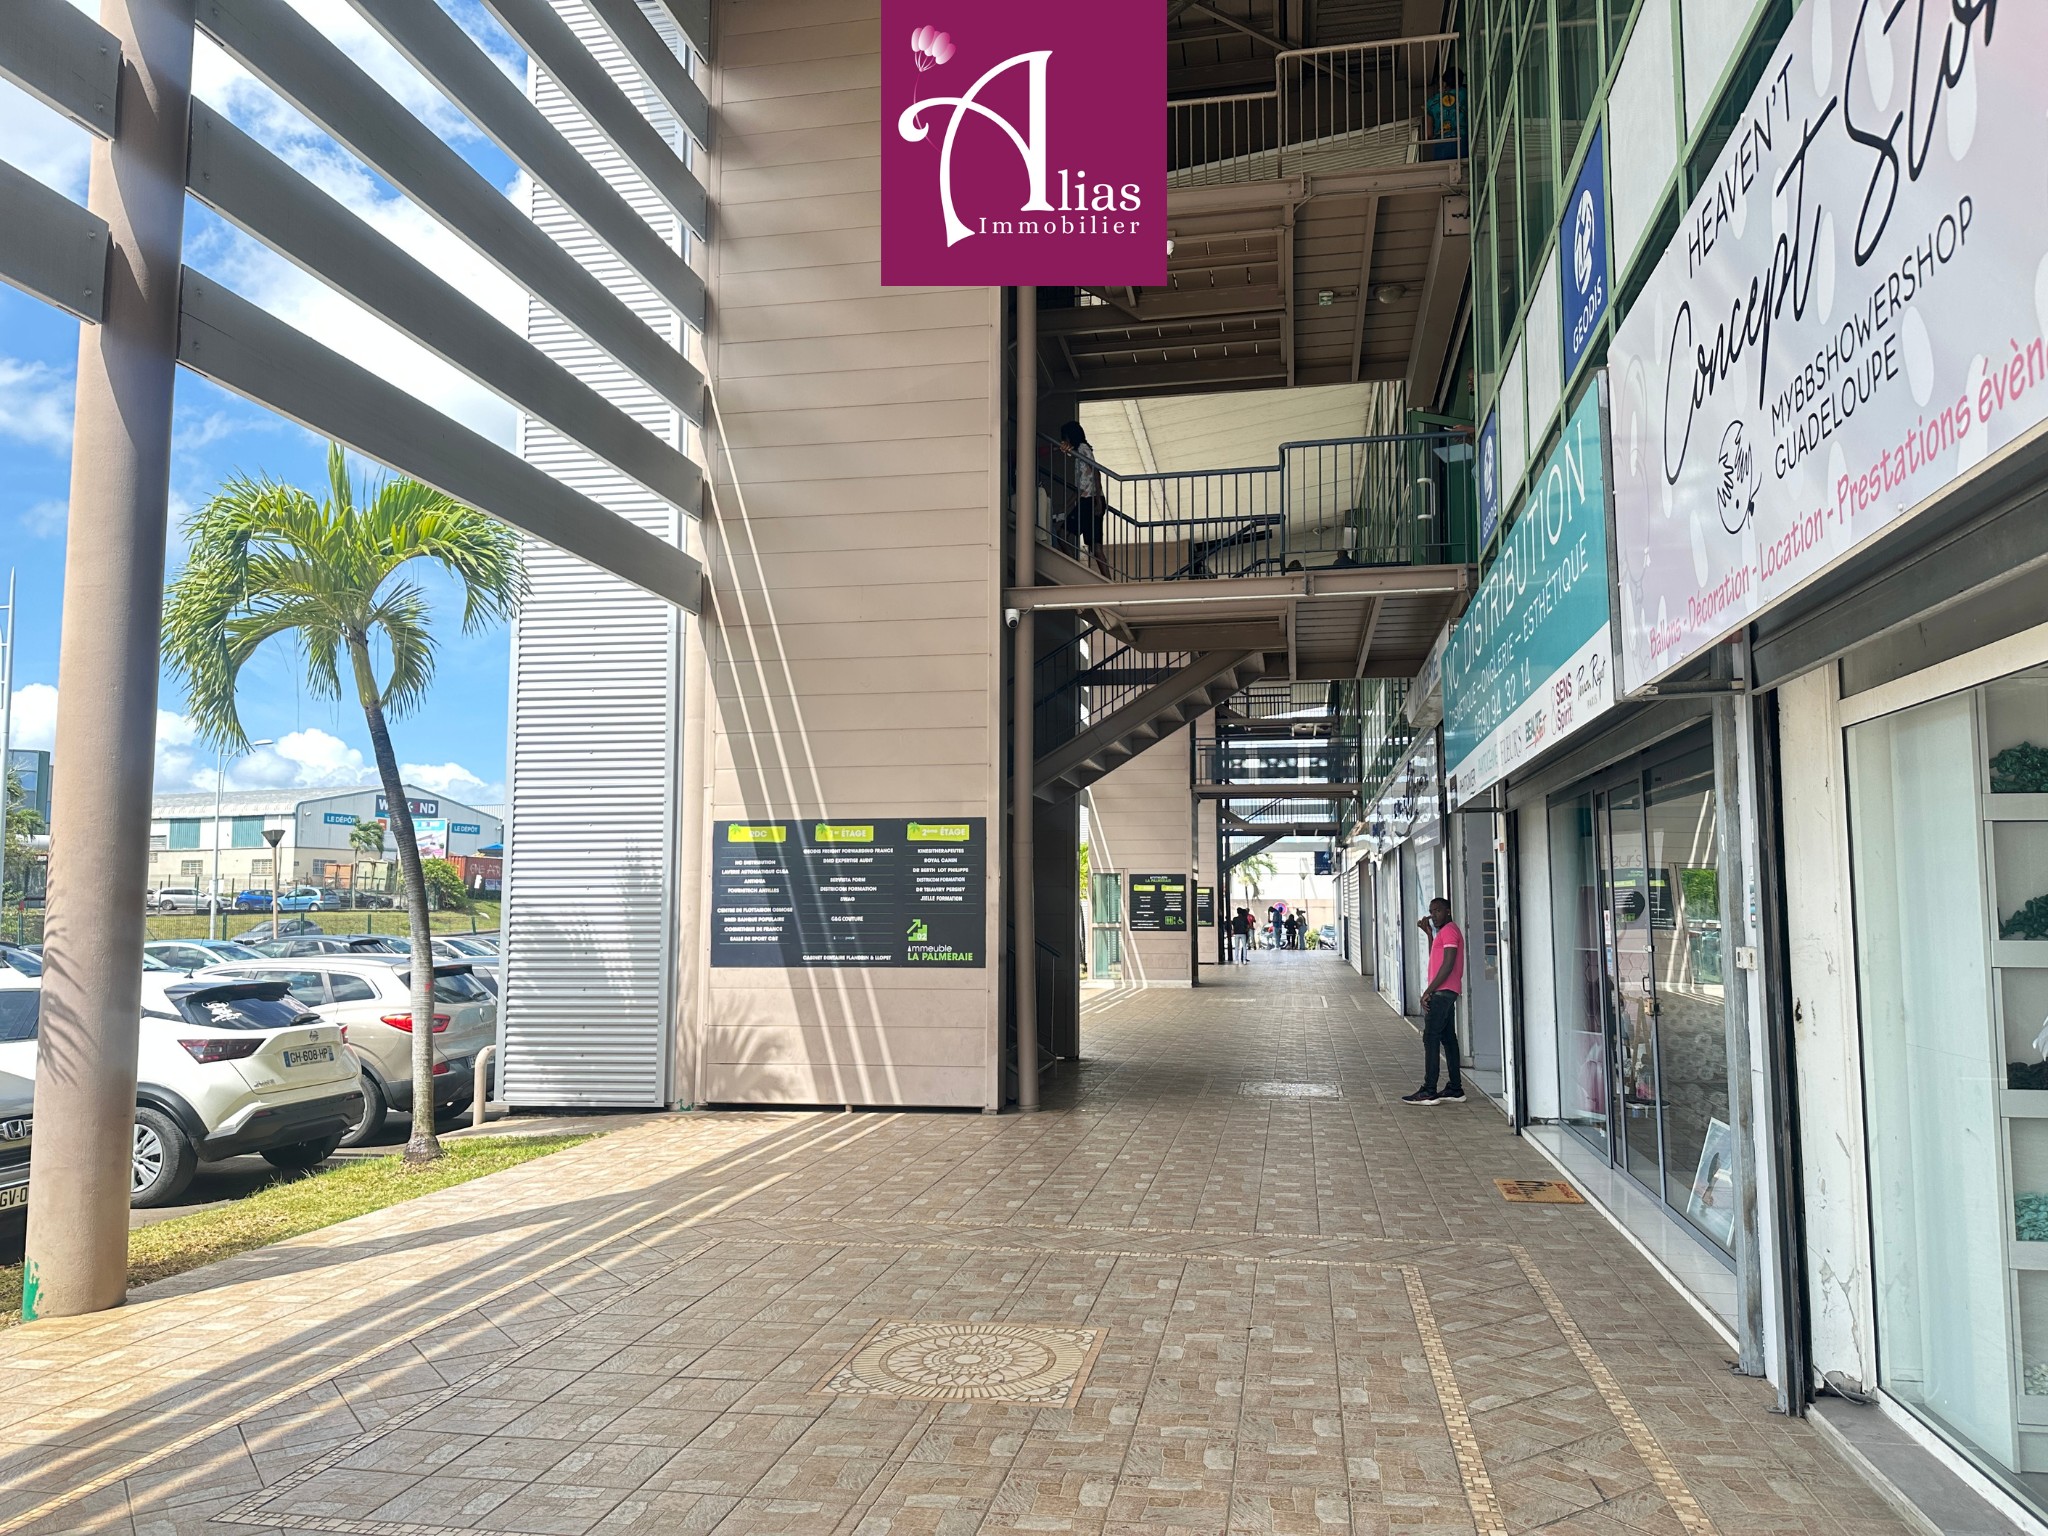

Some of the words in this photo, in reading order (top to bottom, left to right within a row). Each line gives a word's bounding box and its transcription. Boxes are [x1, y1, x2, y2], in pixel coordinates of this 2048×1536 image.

[1687, 53, 1793, 279] HEAVEN'T
[1573, 275, 1602, 354] GEODIS
[1664, 95, 1838, 485] Concept
[1771, 195, 1973, 437] MYBBSHOWERSHOP
[1774, 333, 1899, 479] GUADELOUPE
[1649, 616, 1682, 660] Ballons
[1687, 566, 1750, 633] Décoration
[1758, 508, 1824, 582] Location
[1837, 394, 1971, 525] Prestations
[1978, 336, 2048, 423] évèn
[1446, 641, 1460, 700] NC
[1464, 419, 1586, 675] DISTRIBUTION
[1522, 530, 1589, 646] ESTHÉTIQUE
[1474, 702, 1491, 741] 0590
[1491, 689, 1502, 725] 94
[1505, 673, 1517, 712] 32
[1520, 656, 1531, 697] 14
[327, 815, 335, 823] LE
[841, 828, 866, 837] ÉTAGE
[940, 826, 966, 836] ÉTAGE
[908, 953, 919, 961] LA
[921, 953, 973, 961] PALMERAIE
[289, 1047, 328, 1064] GH-608-HP
